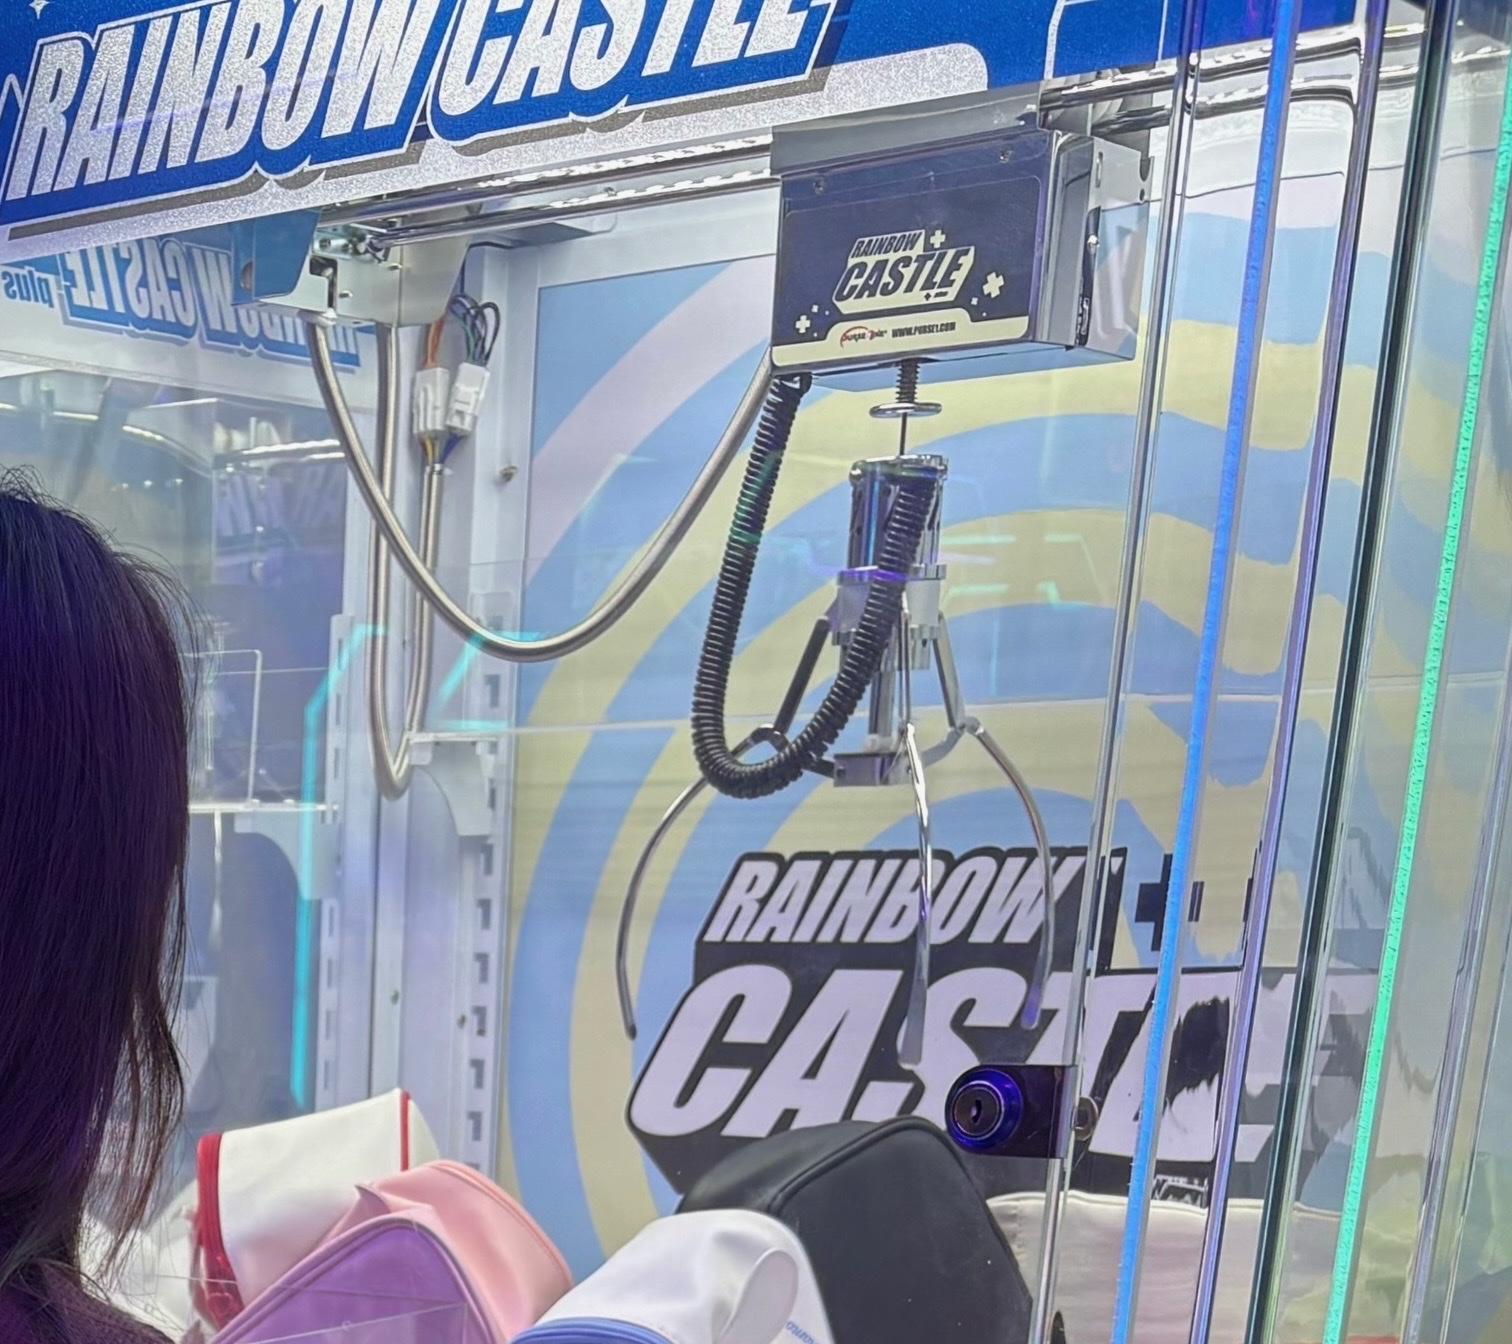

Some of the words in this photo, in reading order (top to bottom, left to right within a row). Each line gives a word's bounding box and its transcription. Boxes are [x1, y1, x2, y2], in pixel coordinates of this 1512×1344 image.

[4, 0, 440, 200] RAINBOW
[835, 246, 972, 302] CASTLE
[850, 231, 922, 260] RAINBOW
[702, 855, 1088, 944] RAINBOW
